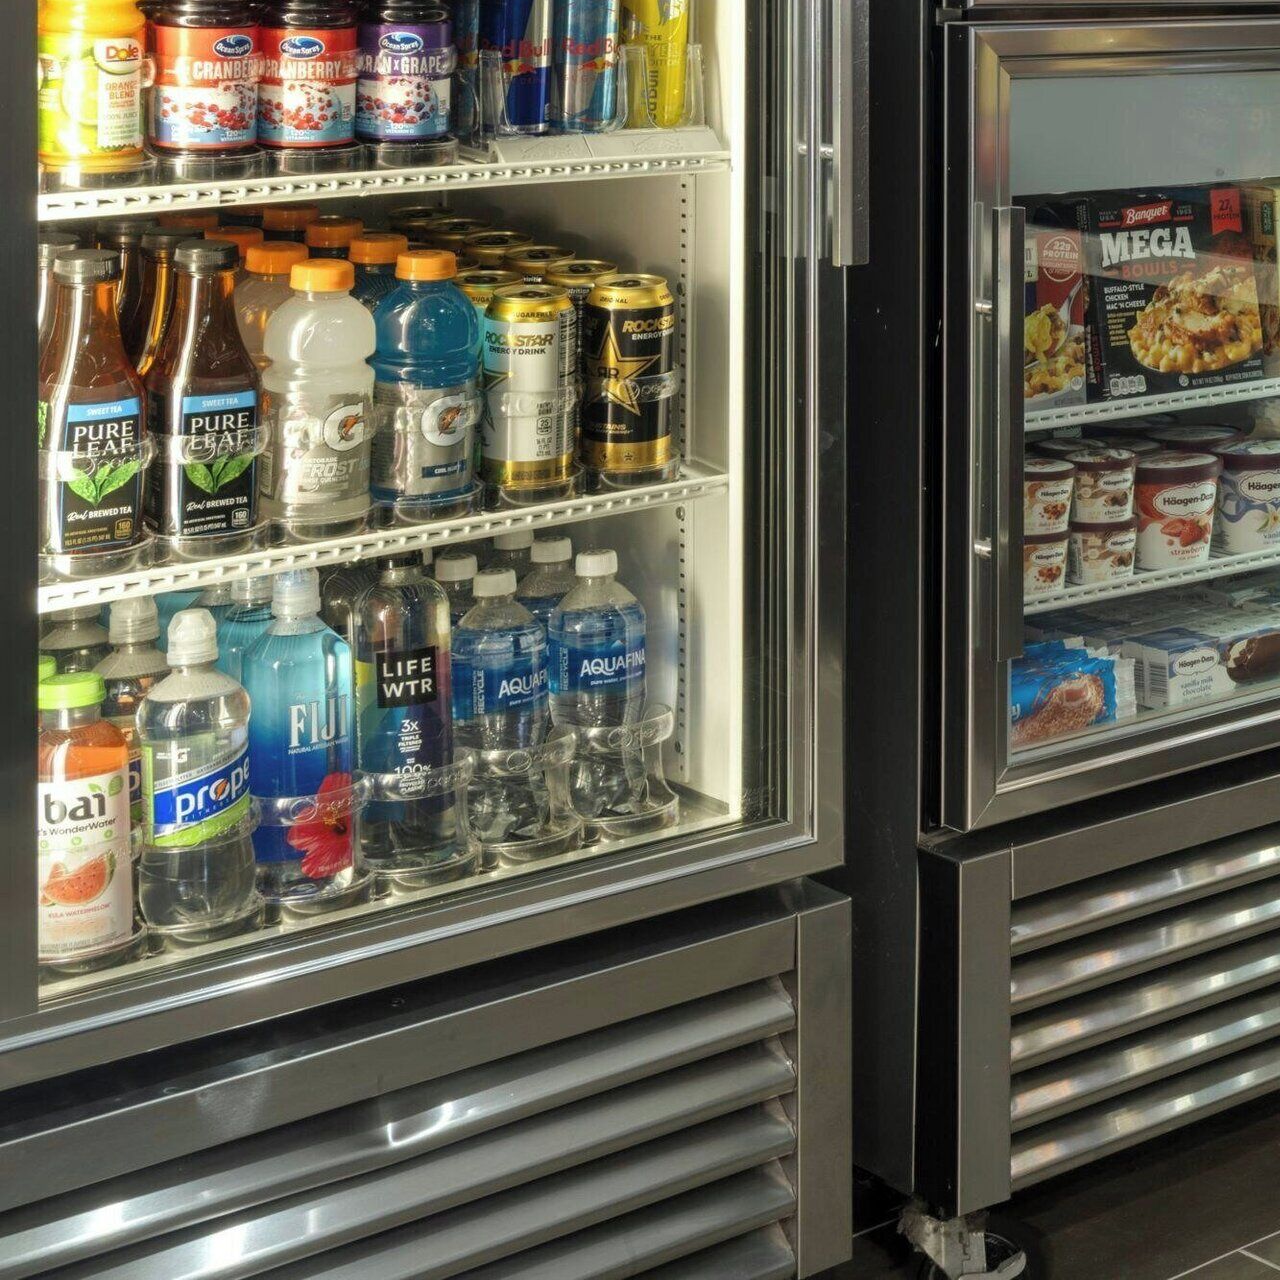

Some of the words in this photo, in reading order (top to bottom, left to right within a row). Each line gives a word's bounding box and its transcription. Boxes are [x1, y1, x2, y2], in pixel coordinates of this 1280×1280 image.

[105, 43, 139, 60] Dole
[109, 91, 135, 99] BLEND
[1126, 205, 1168, 225] Banquet
[1213, 212, 1240, 220] PROTEIN
[1043, 249, 1079, 261] PROTEIN
[1100, 226, 1196, 269] MEGA
[1122, 260, 1178, 279] BOWLS
[1104, 283, 1145, 294] BUFFALO-STYLE
[1105, 293, 1129, 302] CHICKEN
[631, 333, 662, 341] ENERGY
[489, 347, 517, 355] ENERGY
[518, 347, 546, 355] DRINK
[86, 406, 107, 415] SWEET
[108, 405, 122, 413] TEA
[202, 399, 225, 408] SWEET
[73, 421, 134, 442] PURE
[190, 413, 249, 433] PURE
[186, 500, 206, 511] Real
[206, 497, 235, 509] BREWED
[236, 496, 248, 505] TEA
[67, 510, 88, 521] Real
[88, 507, 119, 519] BREWED
[119, 506, 132, 515] TEA
[383, 656, 432, 678] LIFE
[561, 646, 569, 691] RECYCLE
[580, 648, 646, 678] AQUAFINA
[383, 678, 433, 699] WTR
[477, 670, 485, 714] RECYCLE
[1182, 685, 1212, 697] chocolate
[288, 694, 350, 748] FIJI
[44, 789, 106, 824] bai
